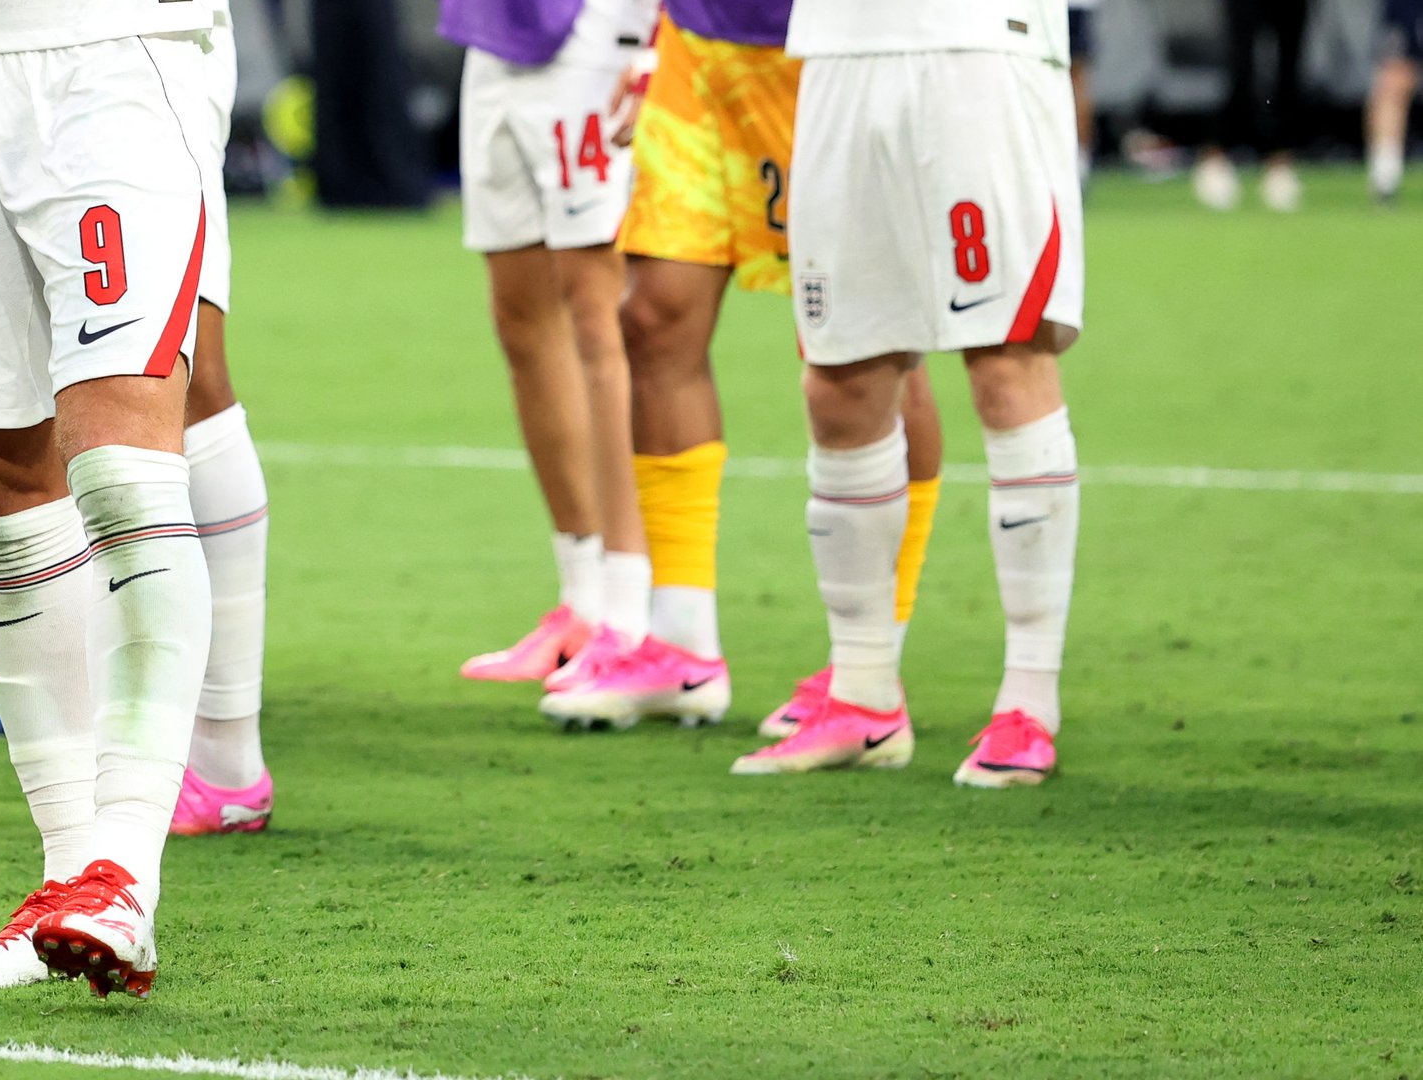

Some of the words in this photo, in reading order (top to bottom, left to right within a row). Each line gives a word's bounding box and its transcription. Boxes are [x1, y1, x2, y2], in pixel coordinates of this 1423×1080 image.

[554, 113, 611, 190] 14
[79, 204, 128, 306] 9
[949, 200, 990, 283] 8
